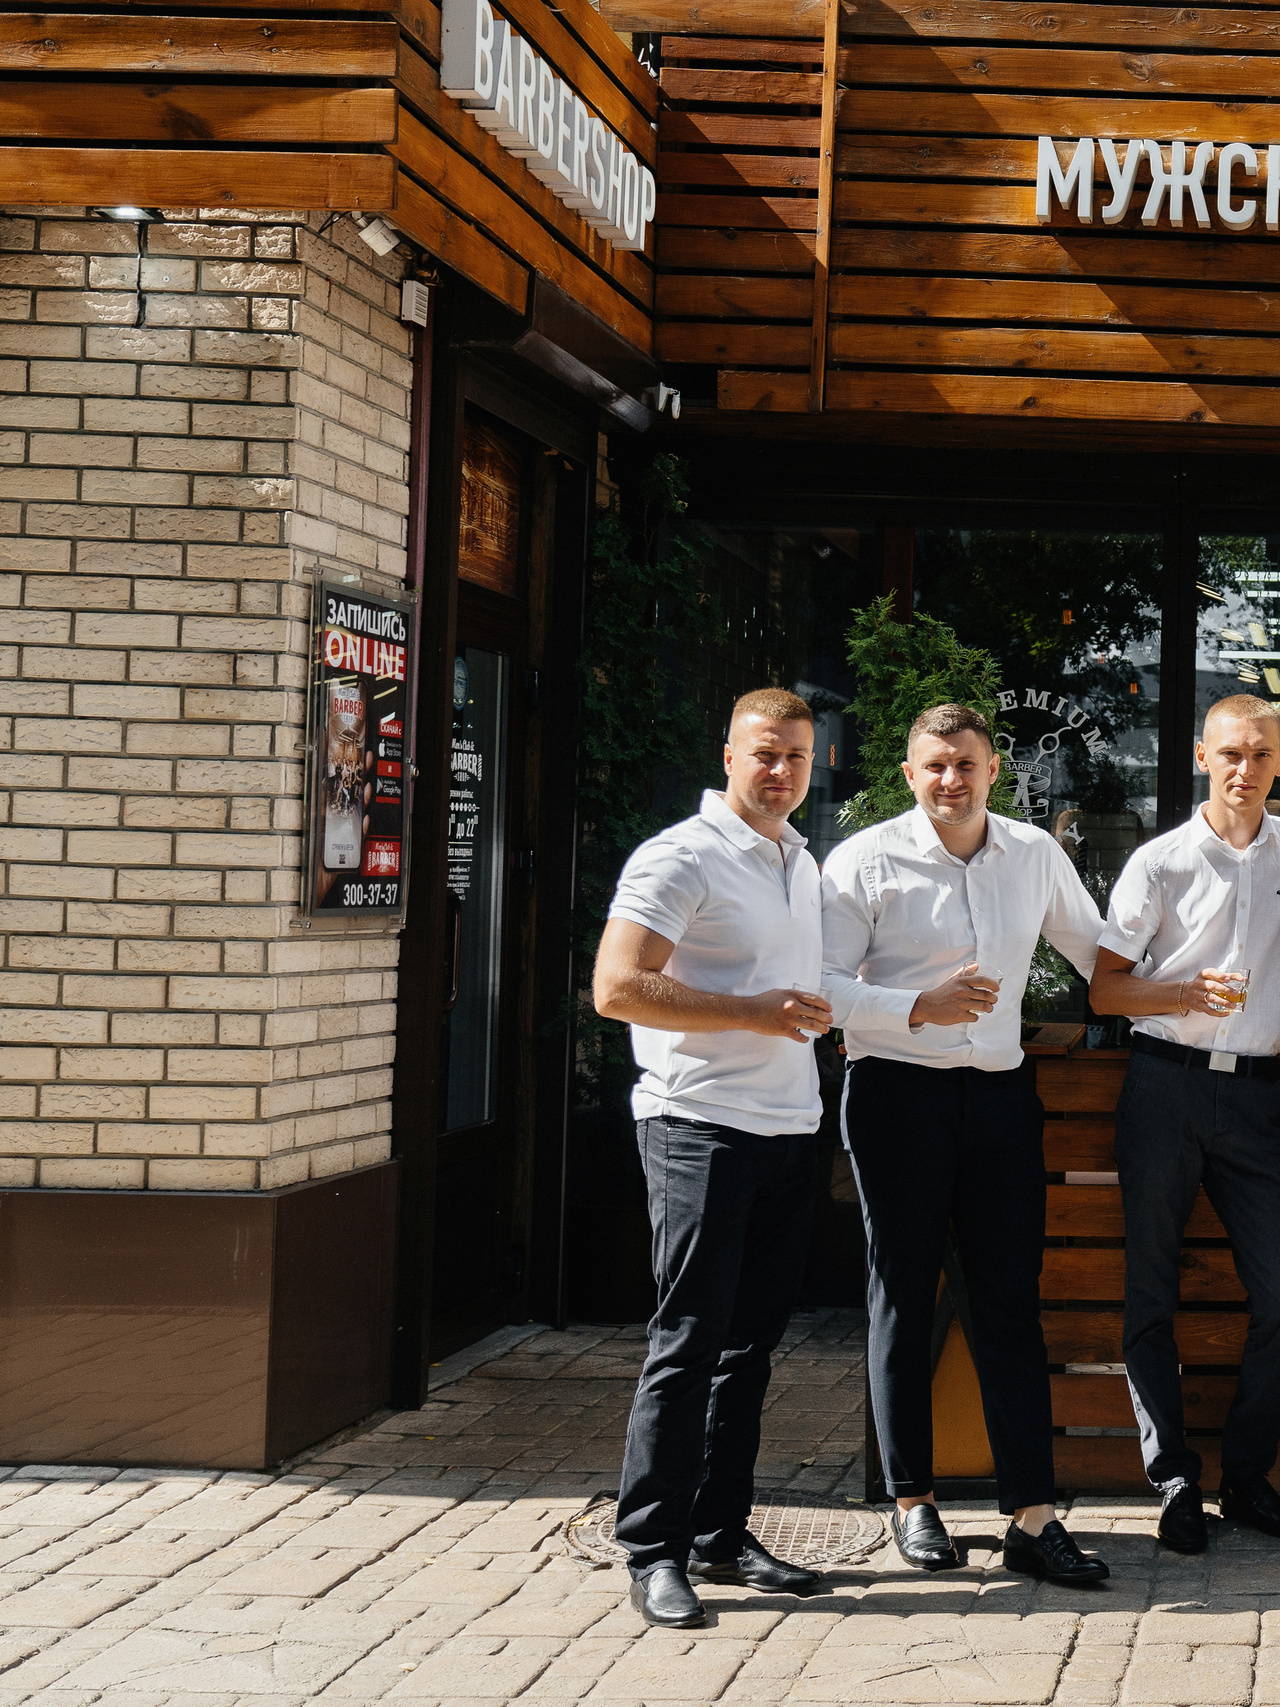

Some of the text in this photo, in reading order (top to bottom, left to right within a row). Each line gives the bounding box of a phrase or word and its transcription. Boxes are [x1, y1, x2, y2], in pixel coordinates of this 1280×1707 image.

[472, 0, 656, 251] BARBERSHOP
[327, 598, 406, 641] ЗАПИШИСЬ
[326, 630, 405, 681] ONLINE
[334, 697, 363, 719] BARBER
[380, 723, 398, 735] СКАЧАЙ
[996, 688, 1108, 757] EMIUM
[1004, 762, 1042, 775] BARBER
[372, 851, 396, 869] BARBER
[343, 883, 398, 906] 300-37-37
